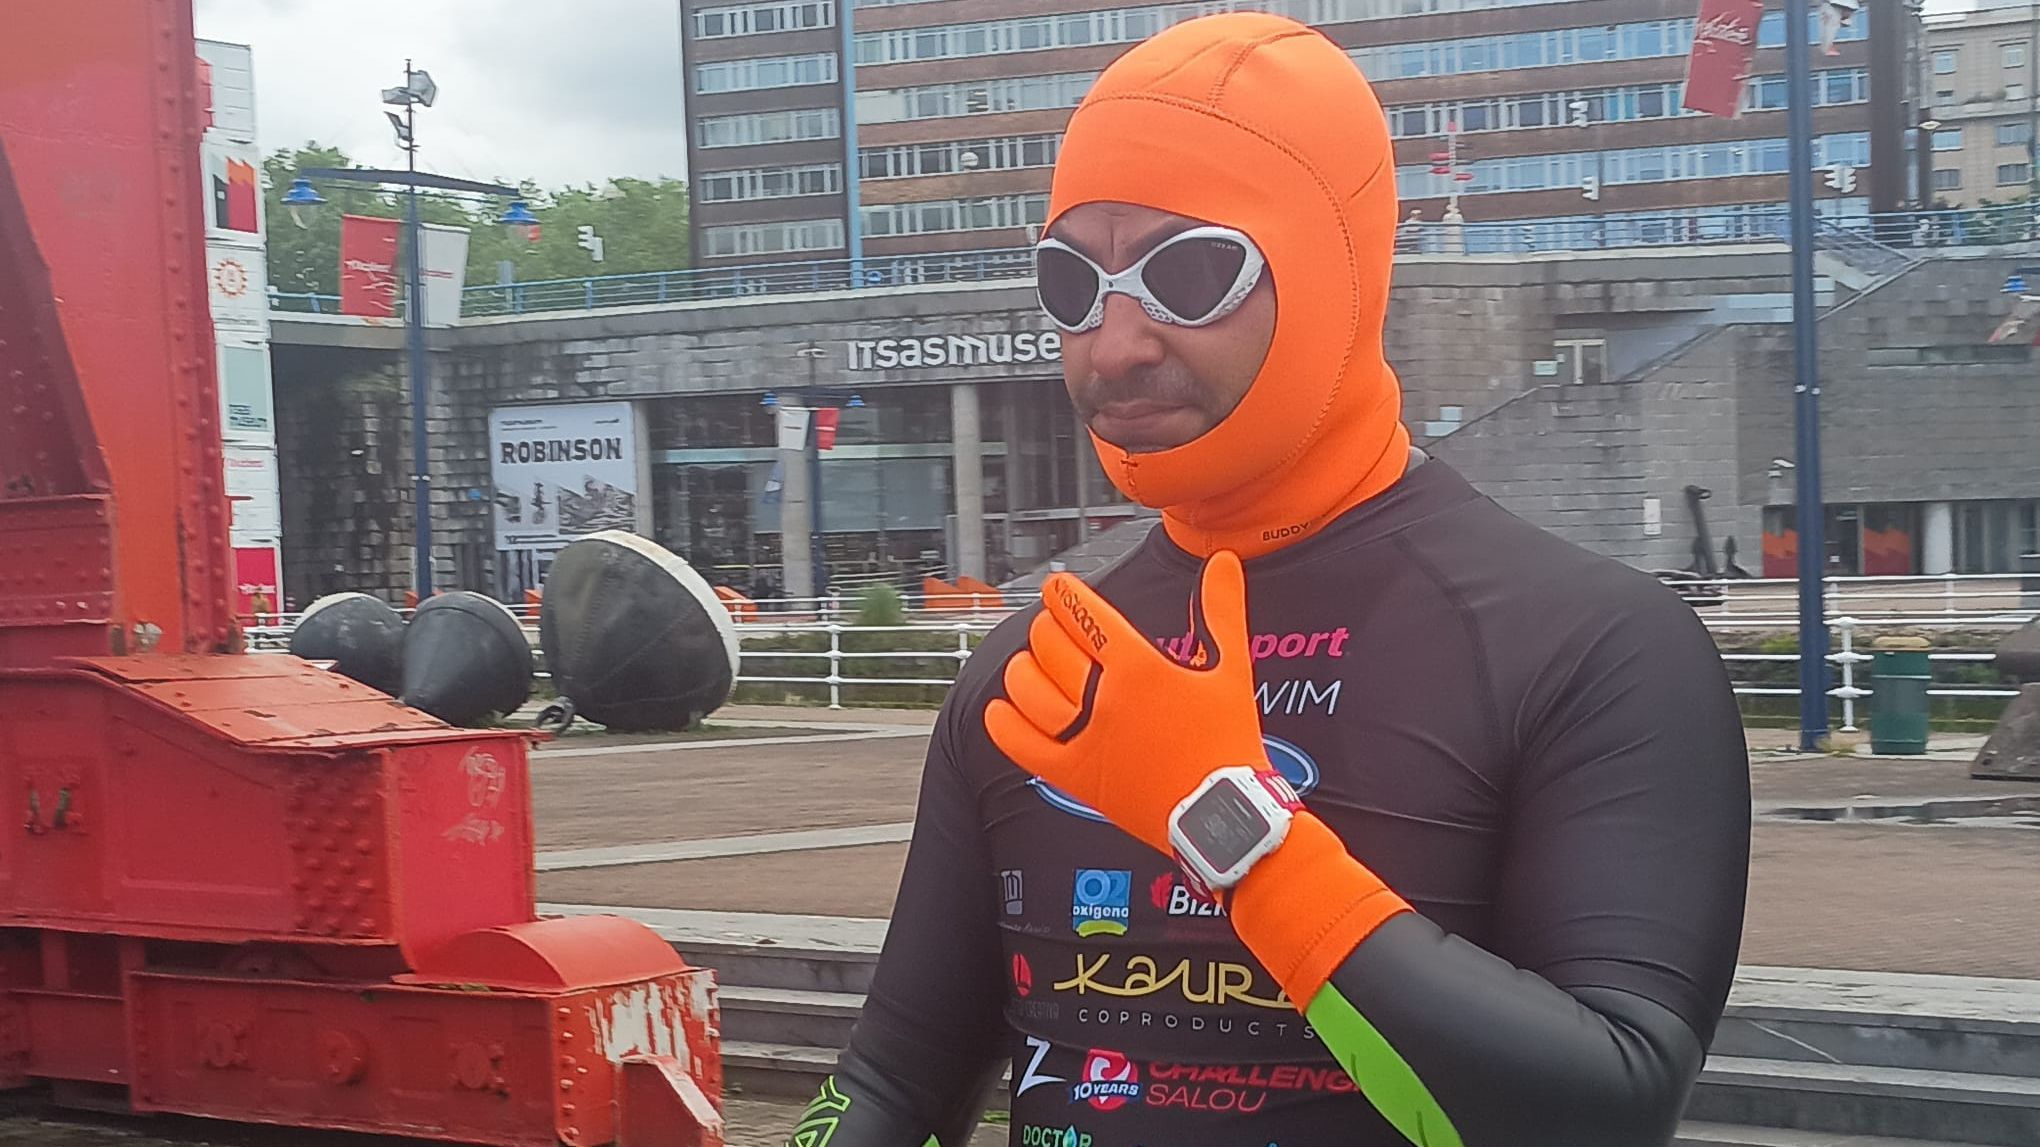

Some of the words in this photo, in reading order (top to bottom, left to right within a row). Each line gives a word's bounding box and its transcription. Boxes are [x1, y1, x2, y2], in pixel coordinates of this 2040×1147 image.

[849, 331, 1062, 370] ITsasmuse
[500, 437, 623, 464] ROBINSON
[1249, 627, 1350, 662] port
[1254, 680, 1342, 715] WIM
[1078, 1008, 1316, 1039] COPRODUCTS
[1150, 1063, 1361, 1093] CHALLENG
[1146, 1084, 1267, 1113] SALOU
